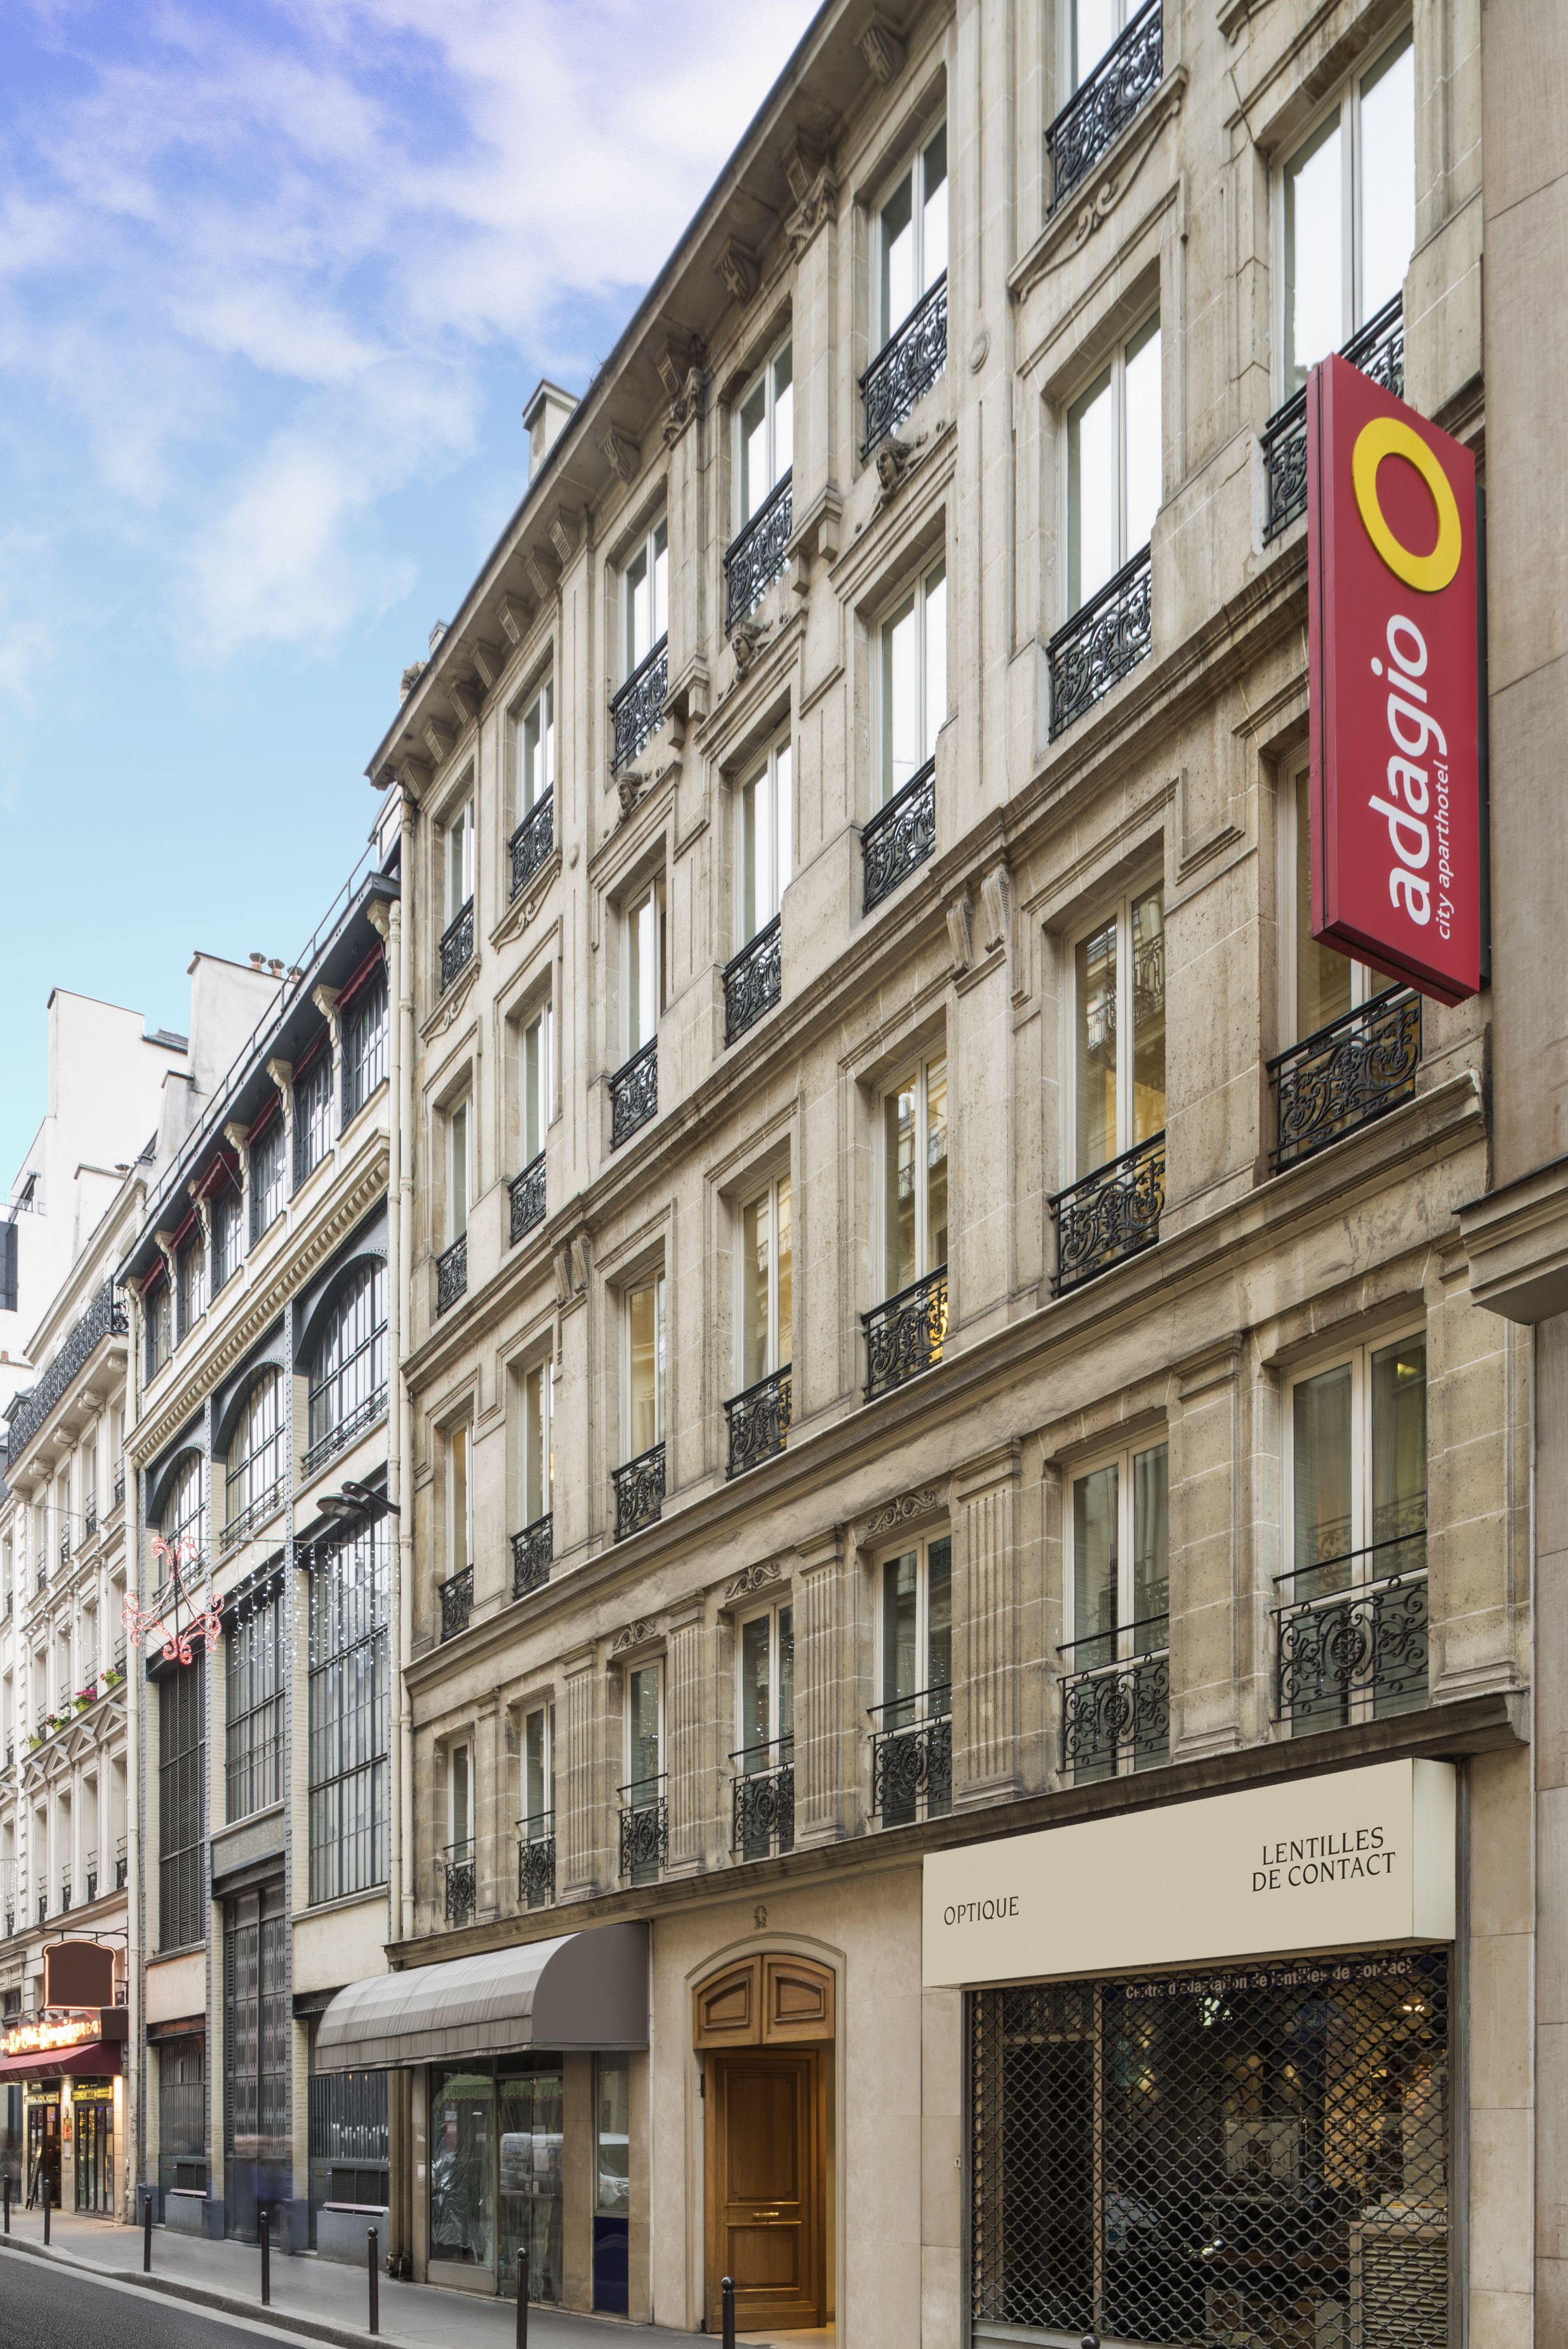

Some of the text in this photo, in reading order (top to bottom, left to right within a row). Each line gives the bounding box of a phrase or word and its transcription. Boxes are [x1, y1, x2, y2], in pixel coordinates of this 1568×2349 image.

[1369, 615, 1447, 926] adagio
[1433, 760, 1454, 940] city aparthotel
[1263, 1827, 1384, 1865] LENTILLES
[1252, 1852, 1396, 1892] DE CONTACT
[944, 1896, 1019, 1926] OPTIQUE
